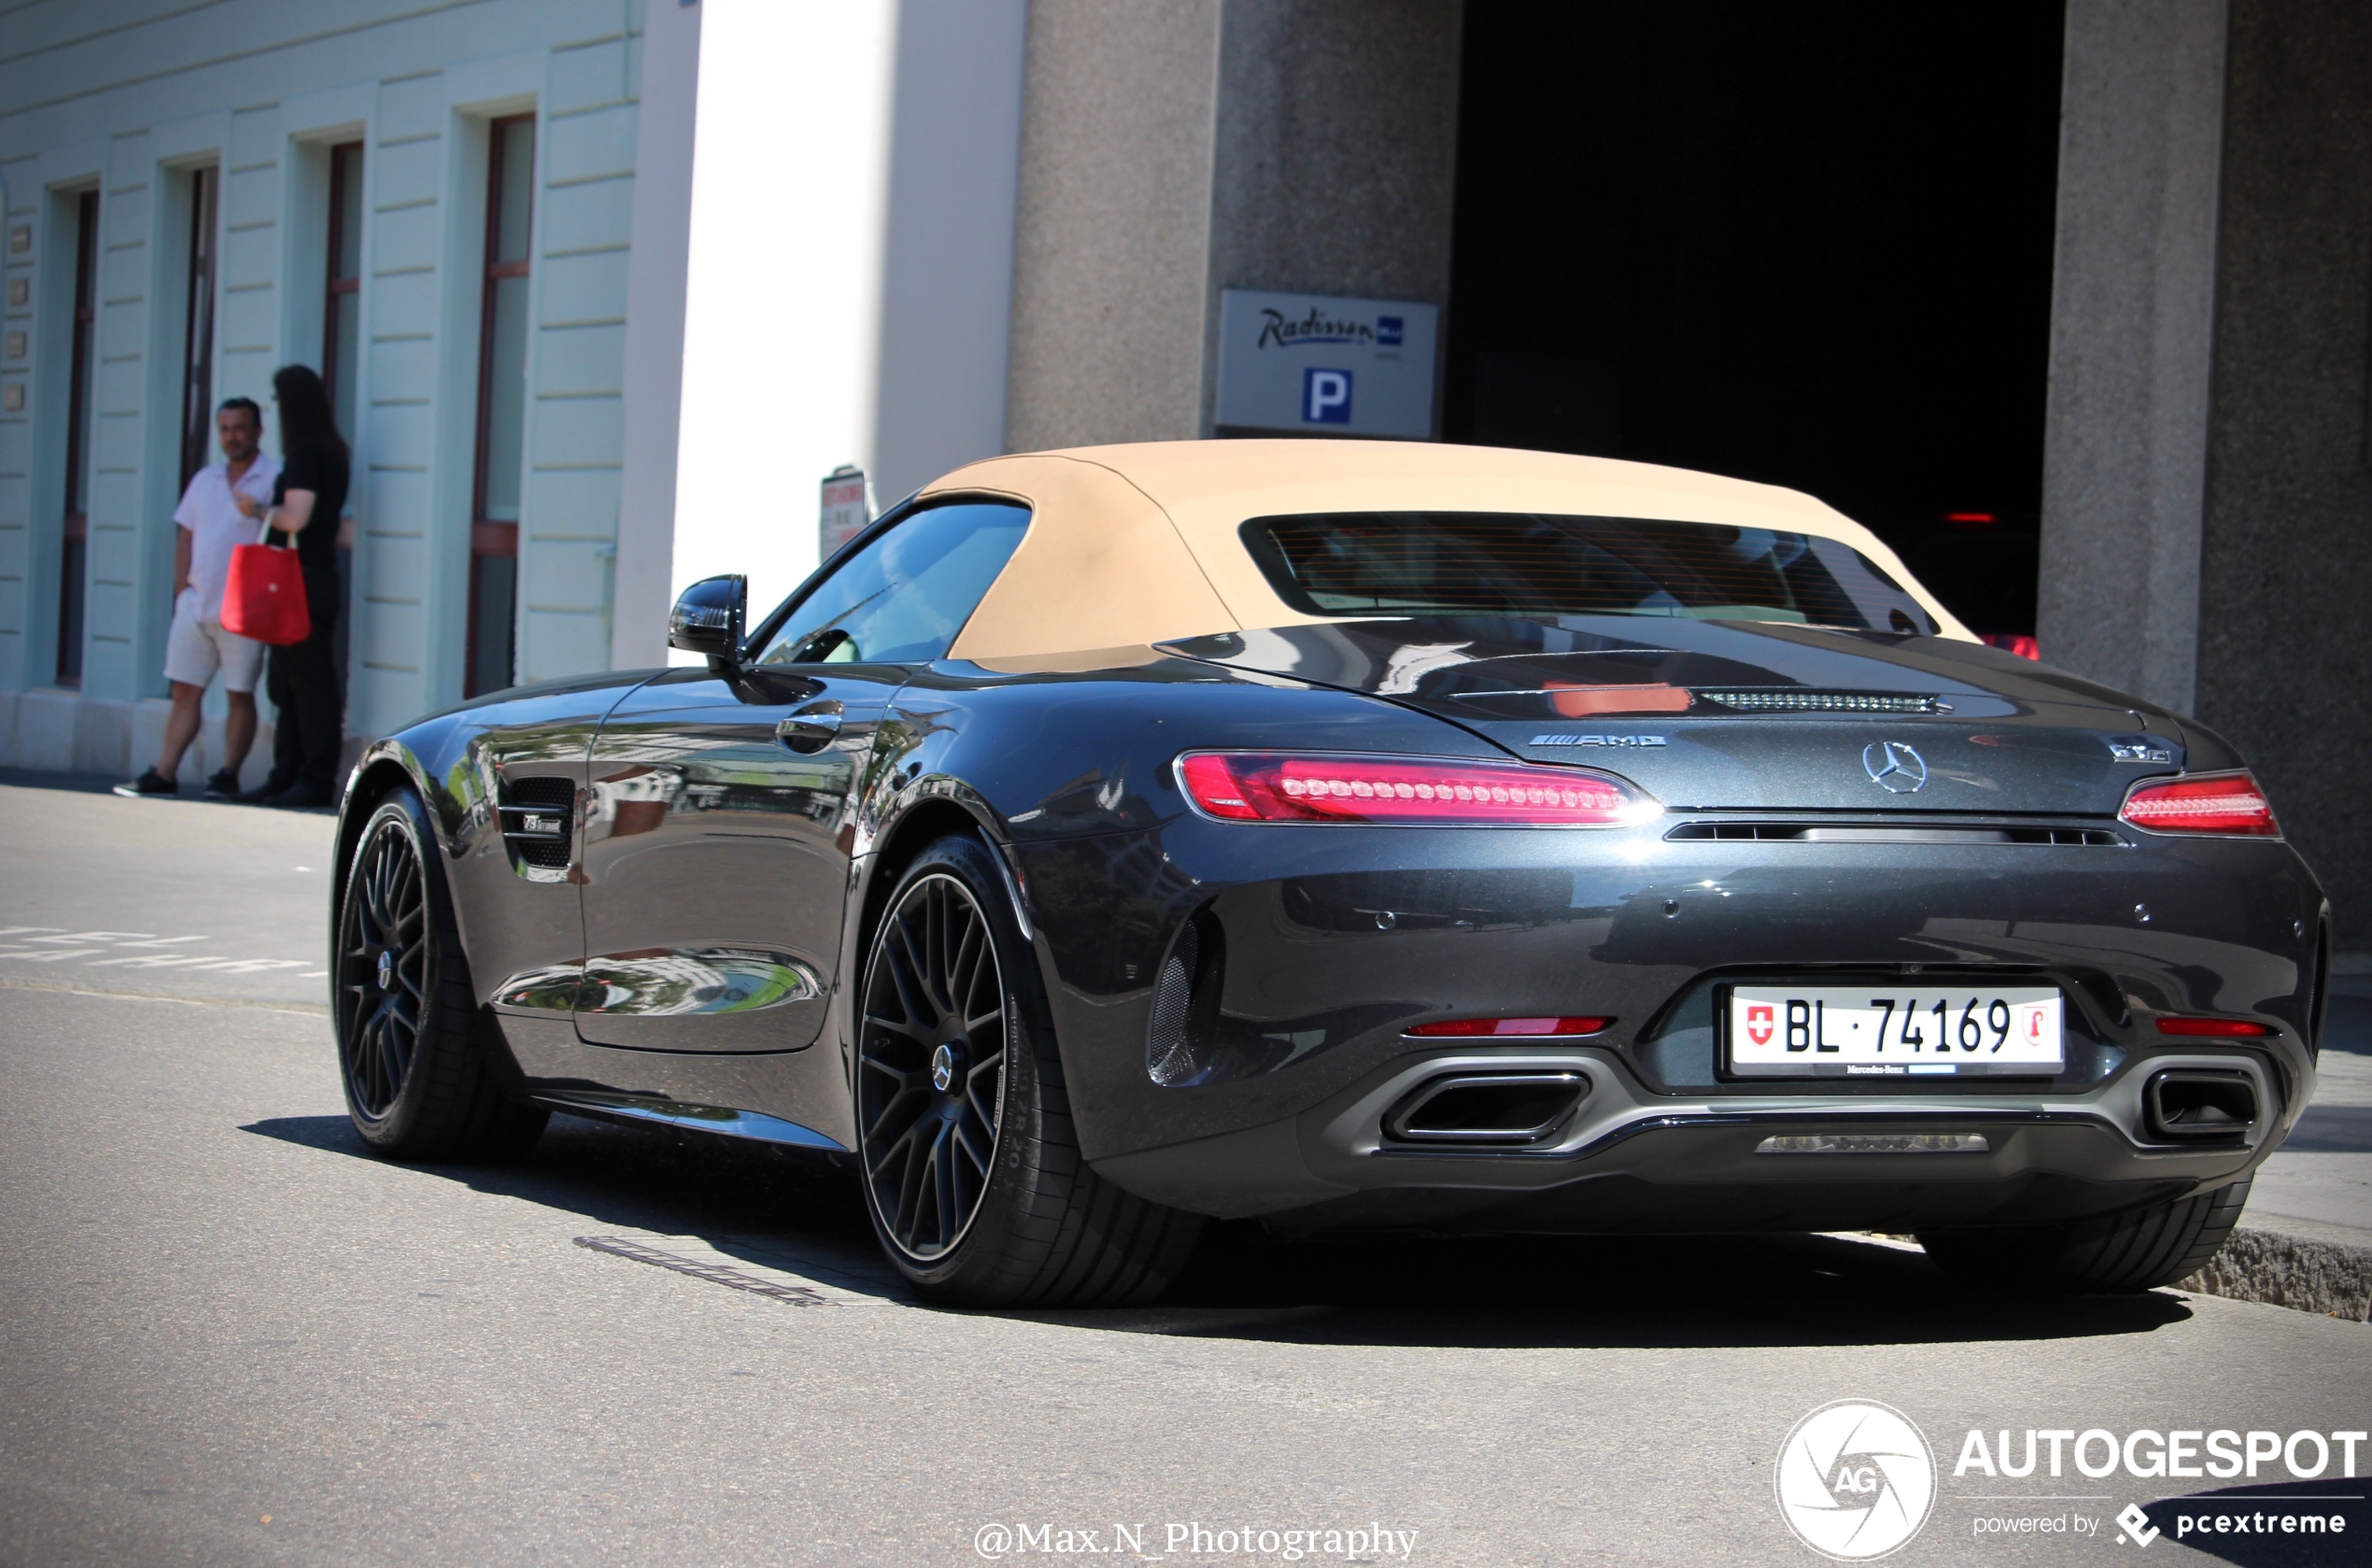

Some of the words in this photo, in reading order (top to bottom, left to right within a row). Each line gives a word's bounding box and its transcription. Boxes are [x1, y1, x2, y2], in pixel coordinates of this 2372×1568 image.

[1257, 305, 1375, 349] Radisson
[1310, 372, 1348, 419] P
[1846, 1065, 1904, 1075] Mercedes-Benz
